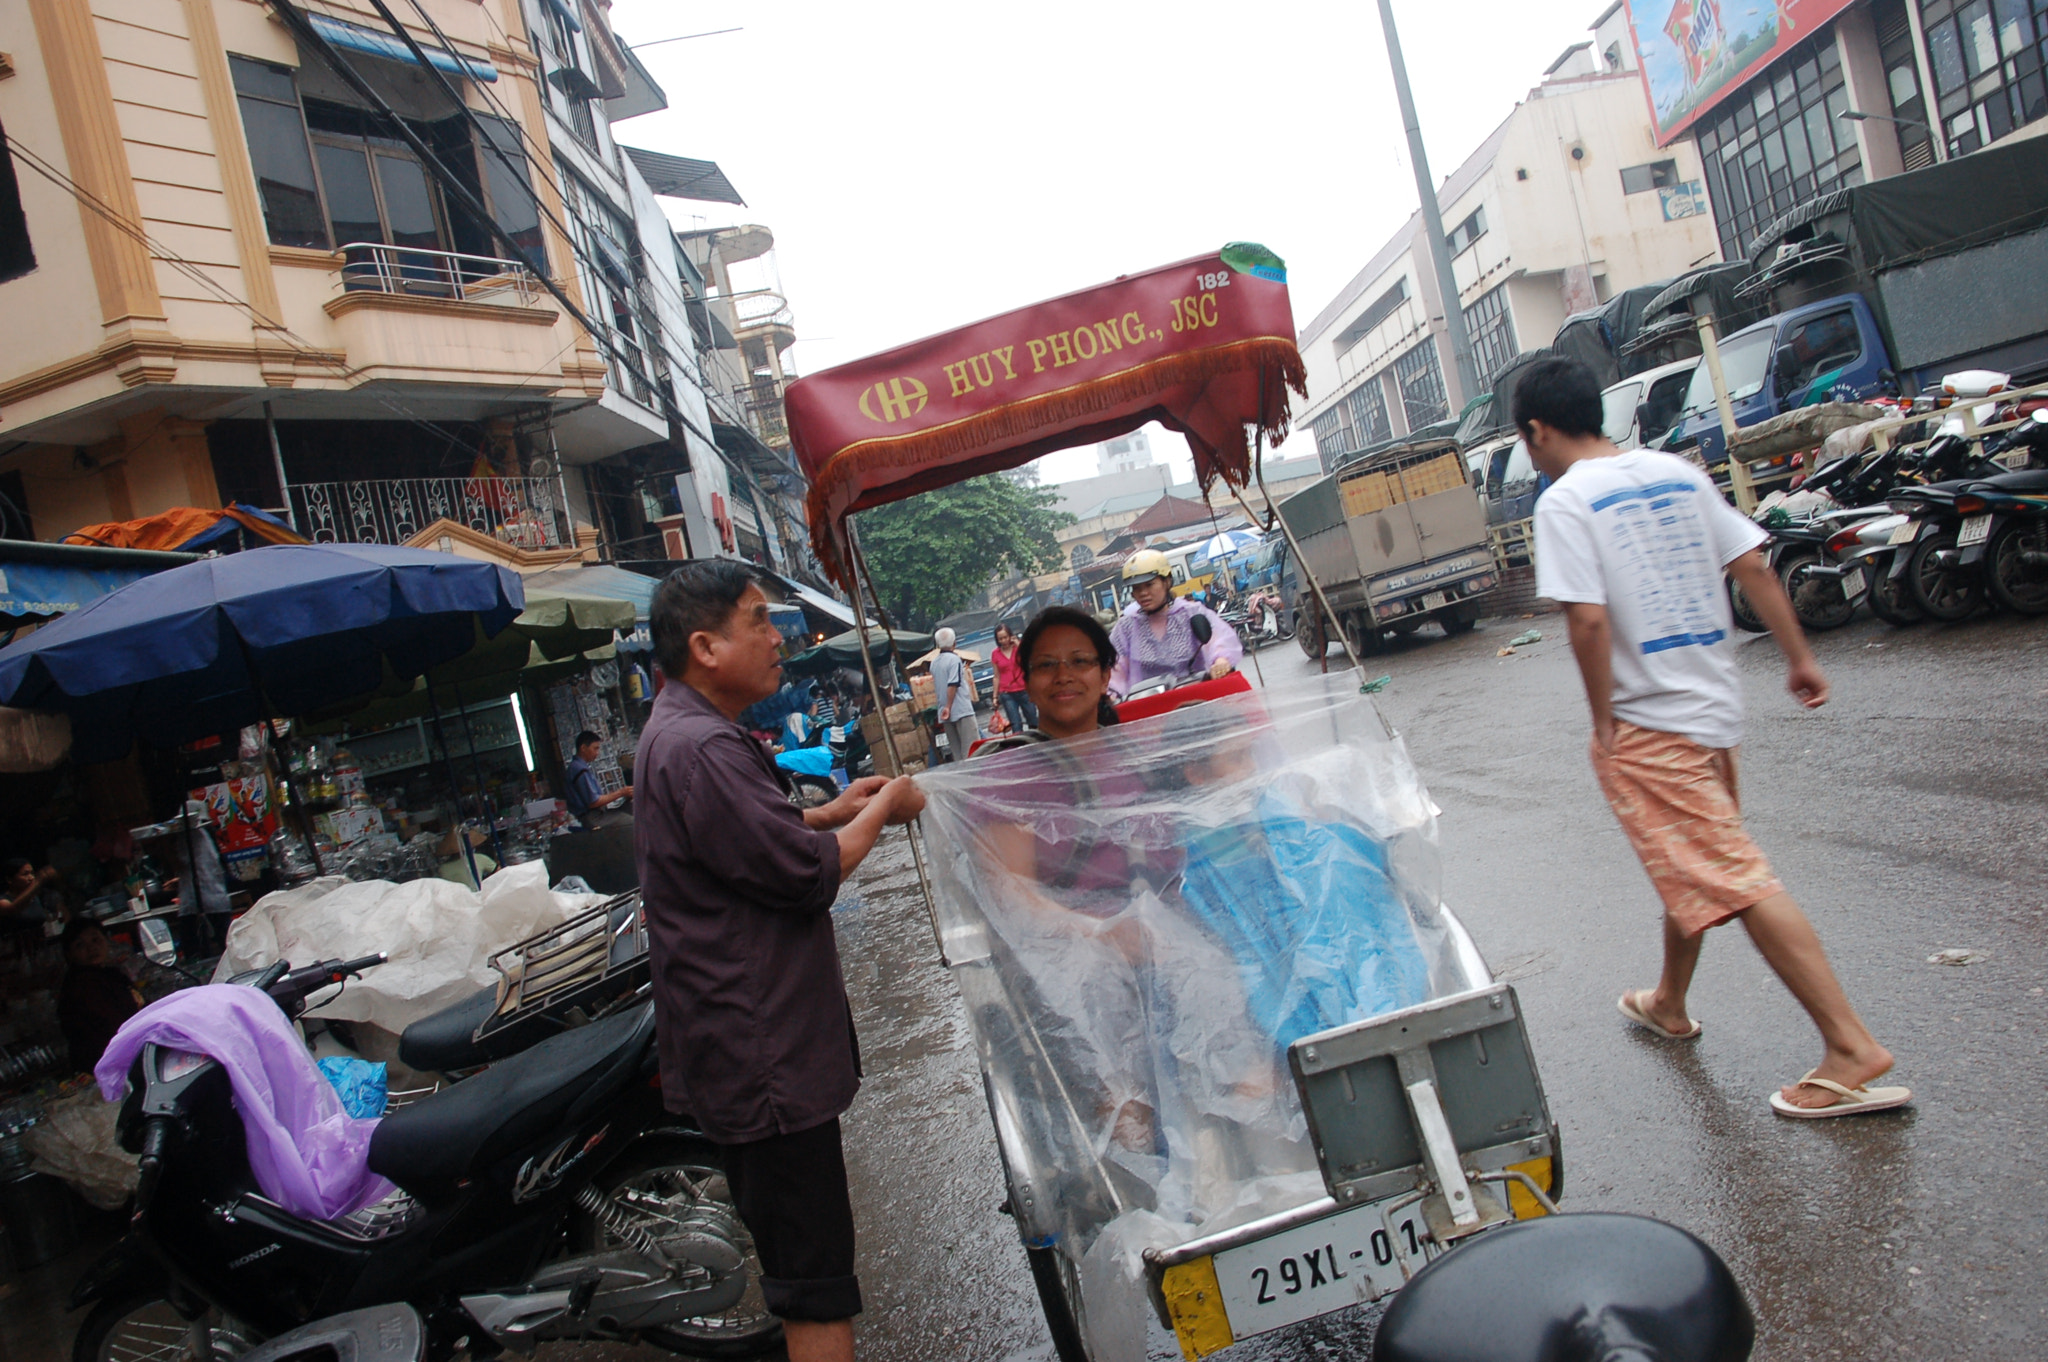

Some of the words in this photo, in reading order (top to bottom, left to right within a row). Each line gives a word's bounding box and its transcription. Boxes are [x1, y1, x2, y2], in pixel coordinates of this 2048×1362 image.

[1686, 0, 1712, 55] OMO
[1196, 270, 1231, 290] 182
[943, 345, 1017, 397] HUY
[1026, 311, 1163, 374] PHONG.,
[1170, 292, 1219, 333] JSC
[228, 1243, 282, 1270] HONDA
